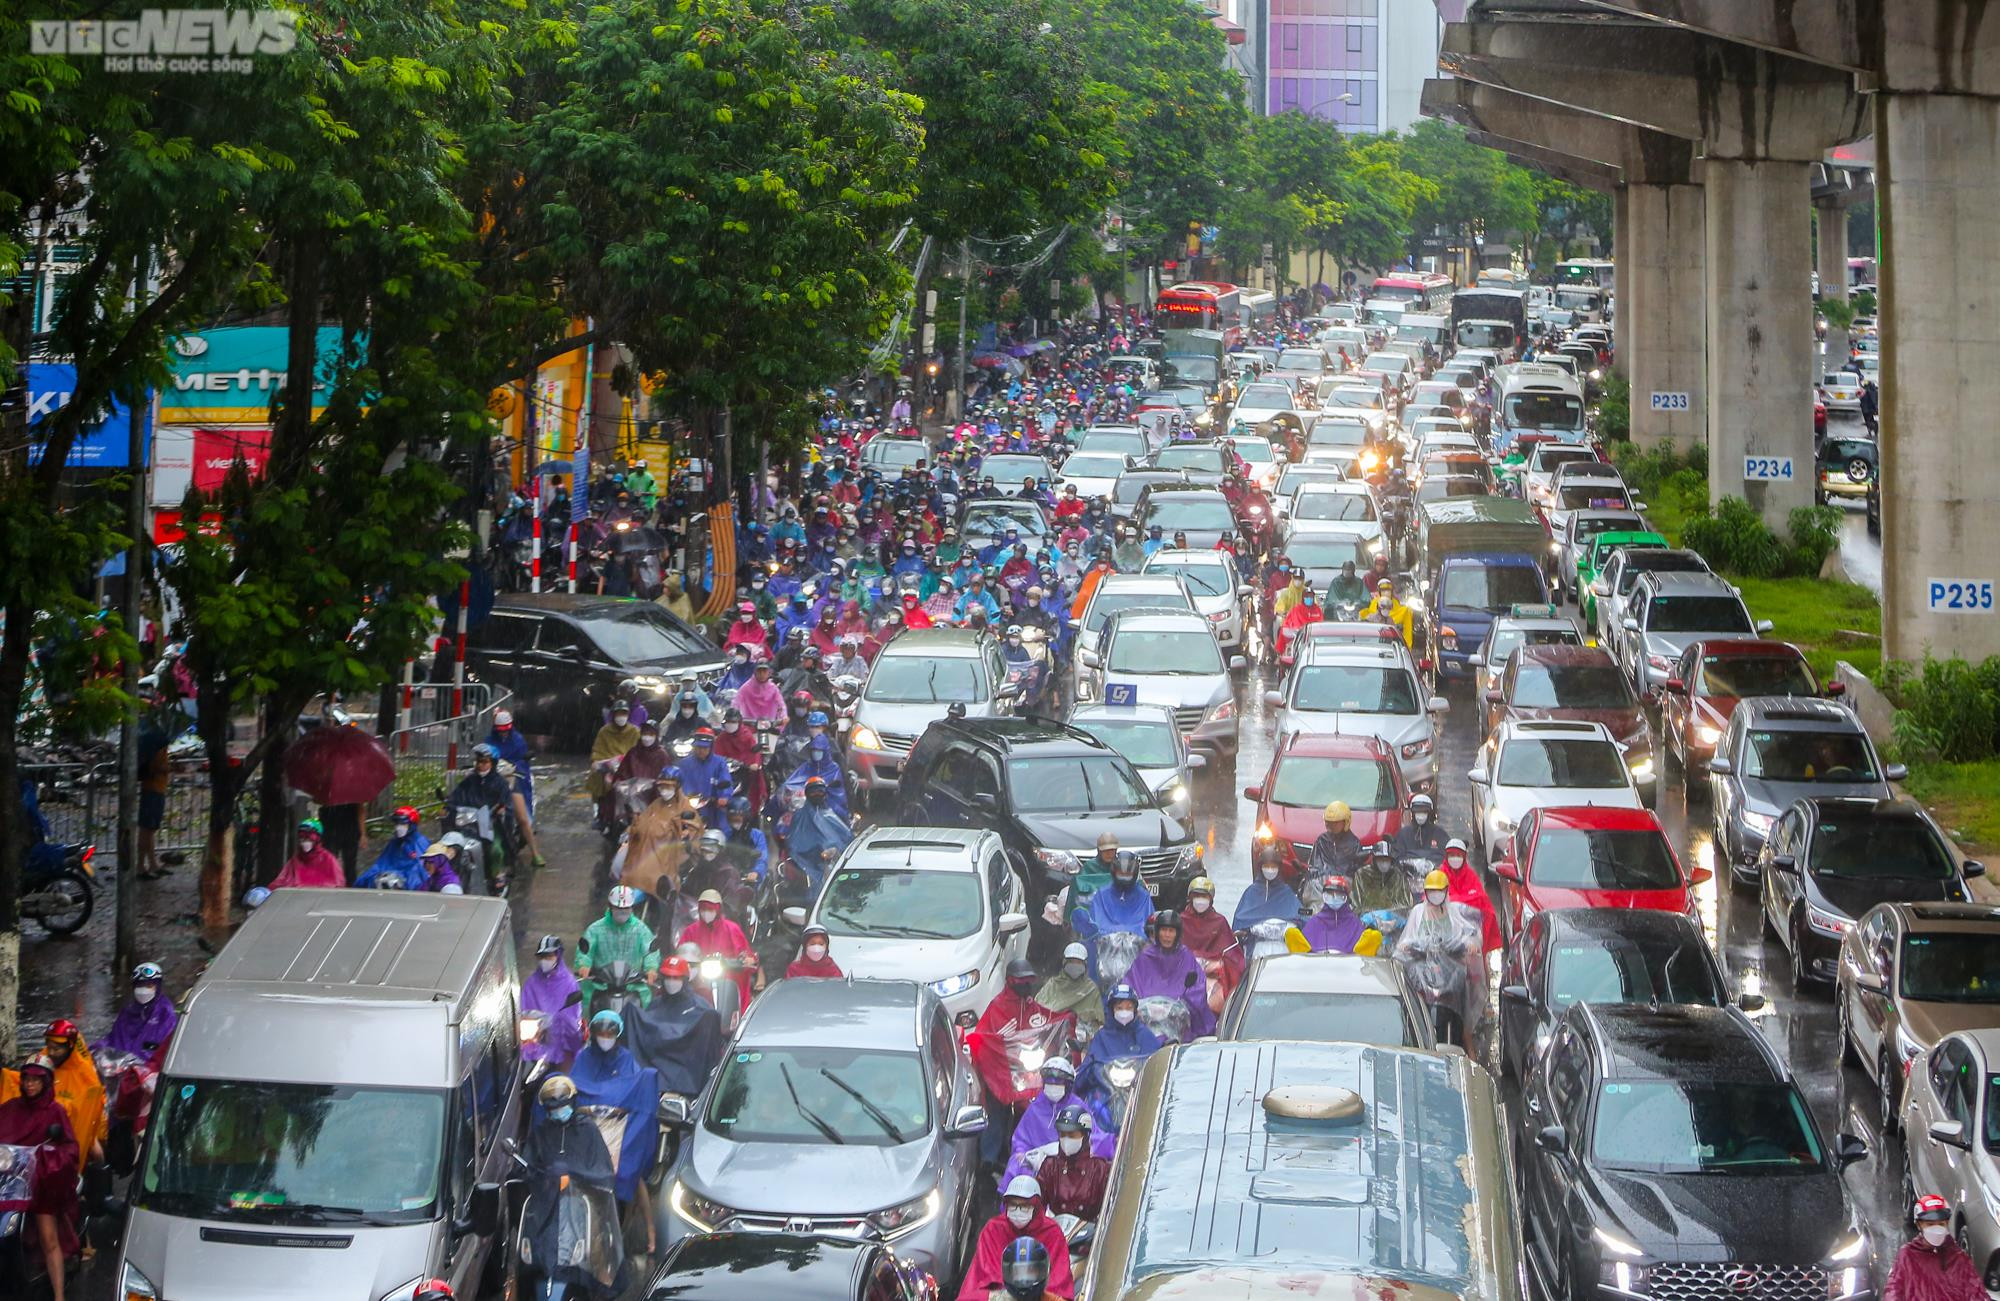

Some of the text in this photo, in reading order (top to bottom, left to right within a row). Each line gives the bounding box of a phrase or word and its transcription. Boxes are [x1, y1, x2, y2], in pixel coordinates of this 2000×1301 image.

[1652, 394, 1687, 408] P233
[1746, 459, 1792, 478] P234
[1931, 583, 1992, 608] P235
